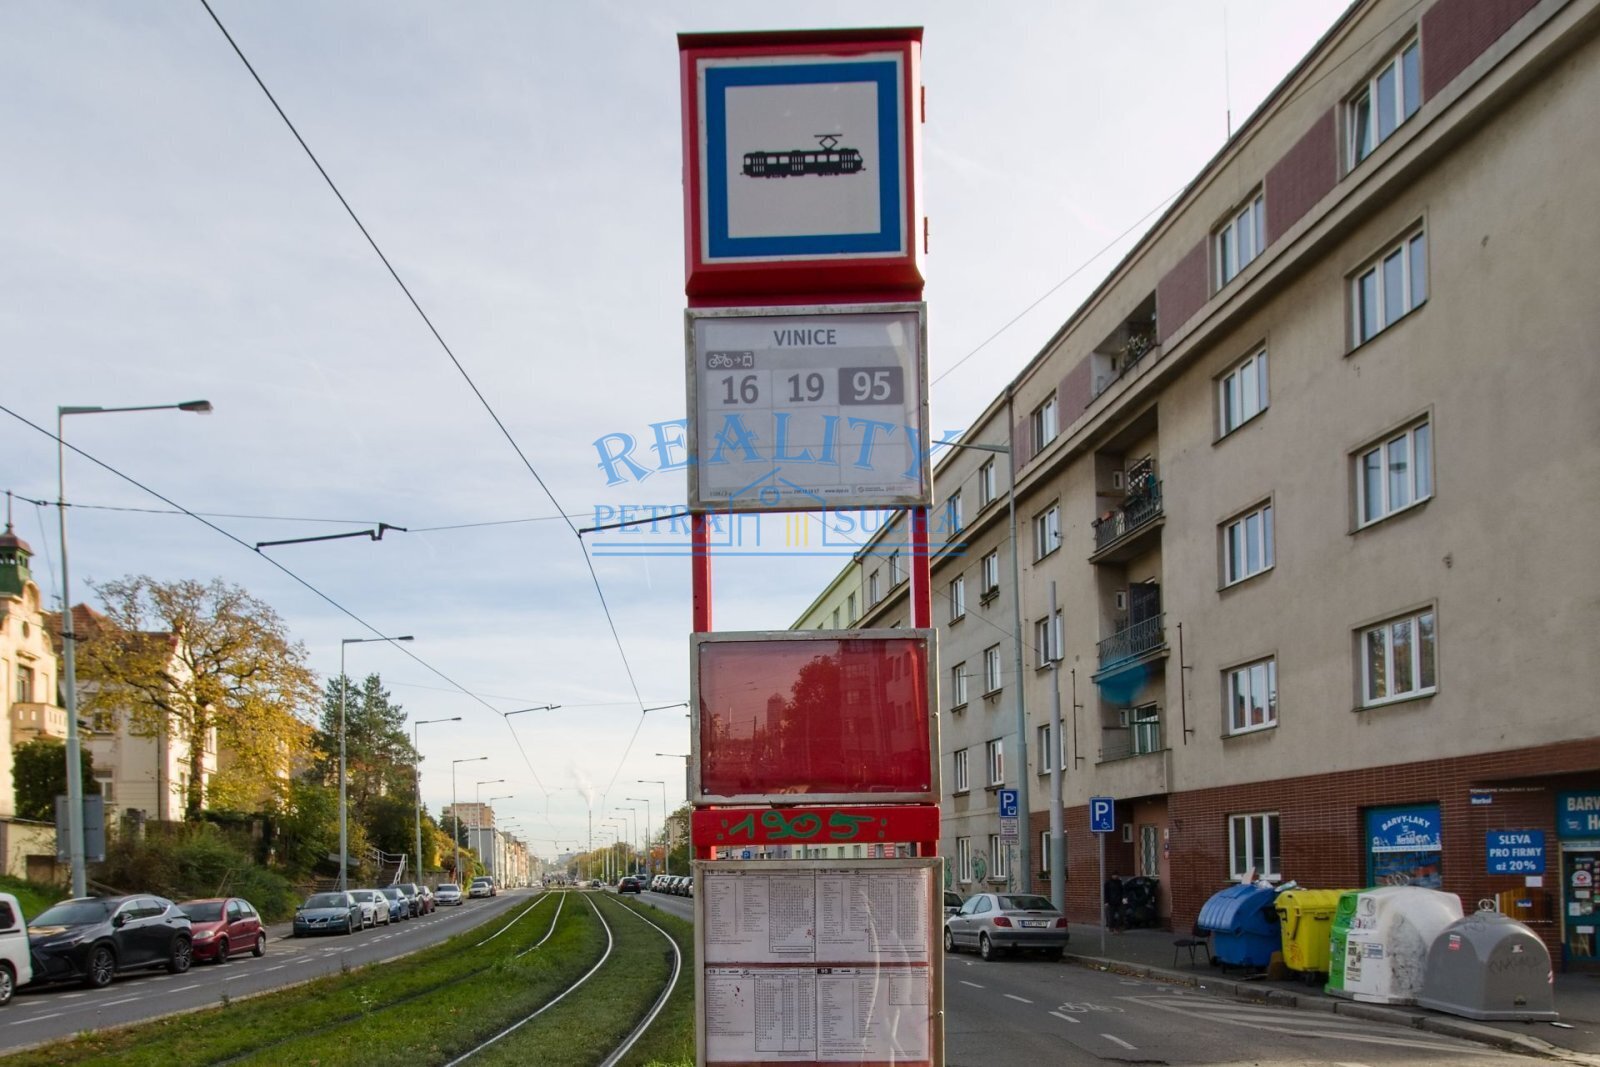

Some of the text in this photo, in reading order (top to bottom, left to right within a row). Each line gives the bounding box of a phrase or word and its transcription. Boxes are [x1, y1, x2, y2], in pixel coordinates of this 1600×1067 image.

[773, 329, 837, 346] VINICE
[722, 371, 892, 404] 16 19 95
[1003, 793, 1015, 808] P
[1095, 802, 1109, 821] P
[1381, 815, 1431, 831] BARVY-LAKY
[1588, 814, 1600, 830] H
[1498, 834, 1531, 844] SLEVA
[1489, 847, 1542, 857] PRO FIRMY
[1495, 860, 1537, 871] až 20%
